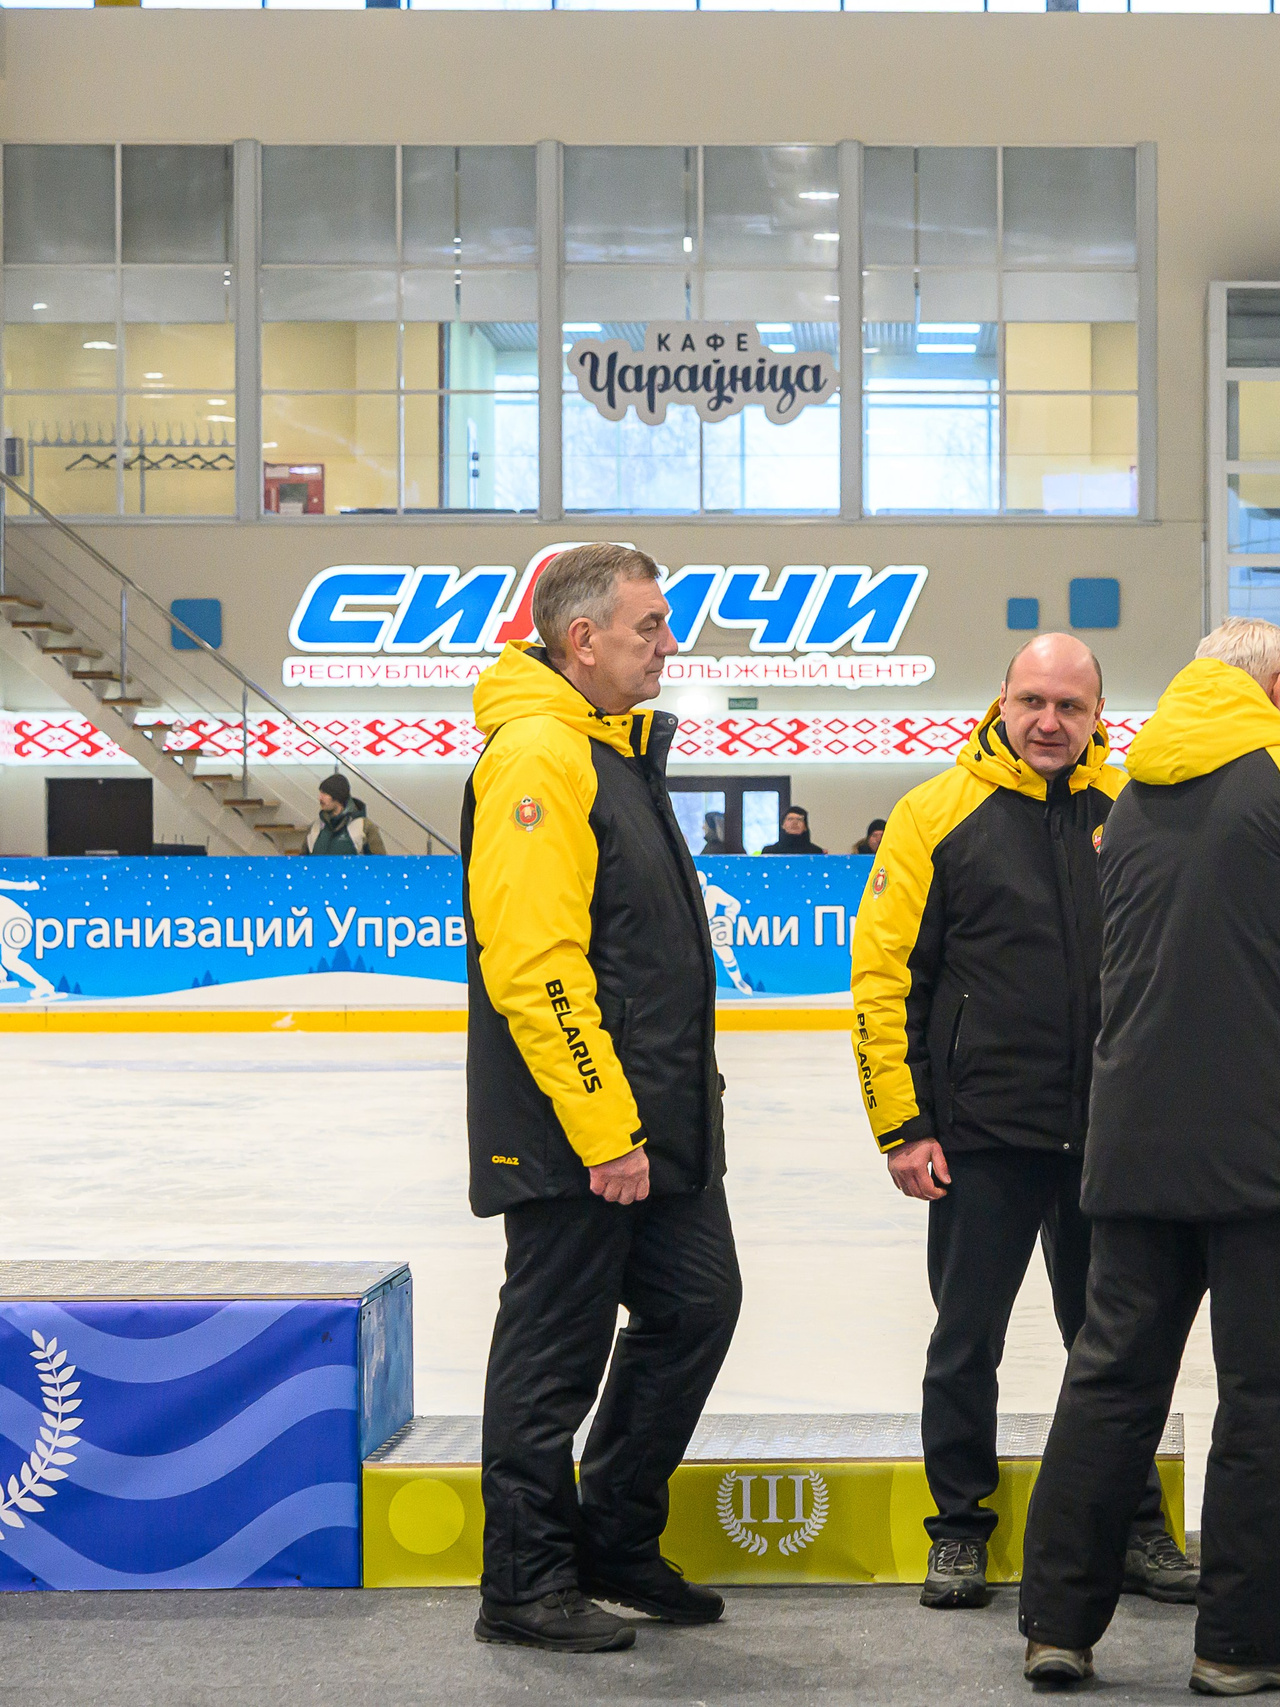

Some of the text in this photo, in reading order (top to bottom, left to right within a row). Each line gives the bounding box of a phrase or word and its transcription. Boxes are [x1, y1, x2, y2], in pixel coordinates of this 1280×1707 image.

[657, 333, 748, 352] КАФЕ
[579, 350, 828, 414] Чараўніца
[290, 660, 928, 682] РЕСПУБЛИКА ОЛЫЖНЫЙ ЦЕНТР
[3, 901, 314, 960] организаций
[544, 978, 603, 1094] BELARUS
[735, 1474, 811, 1524] III
